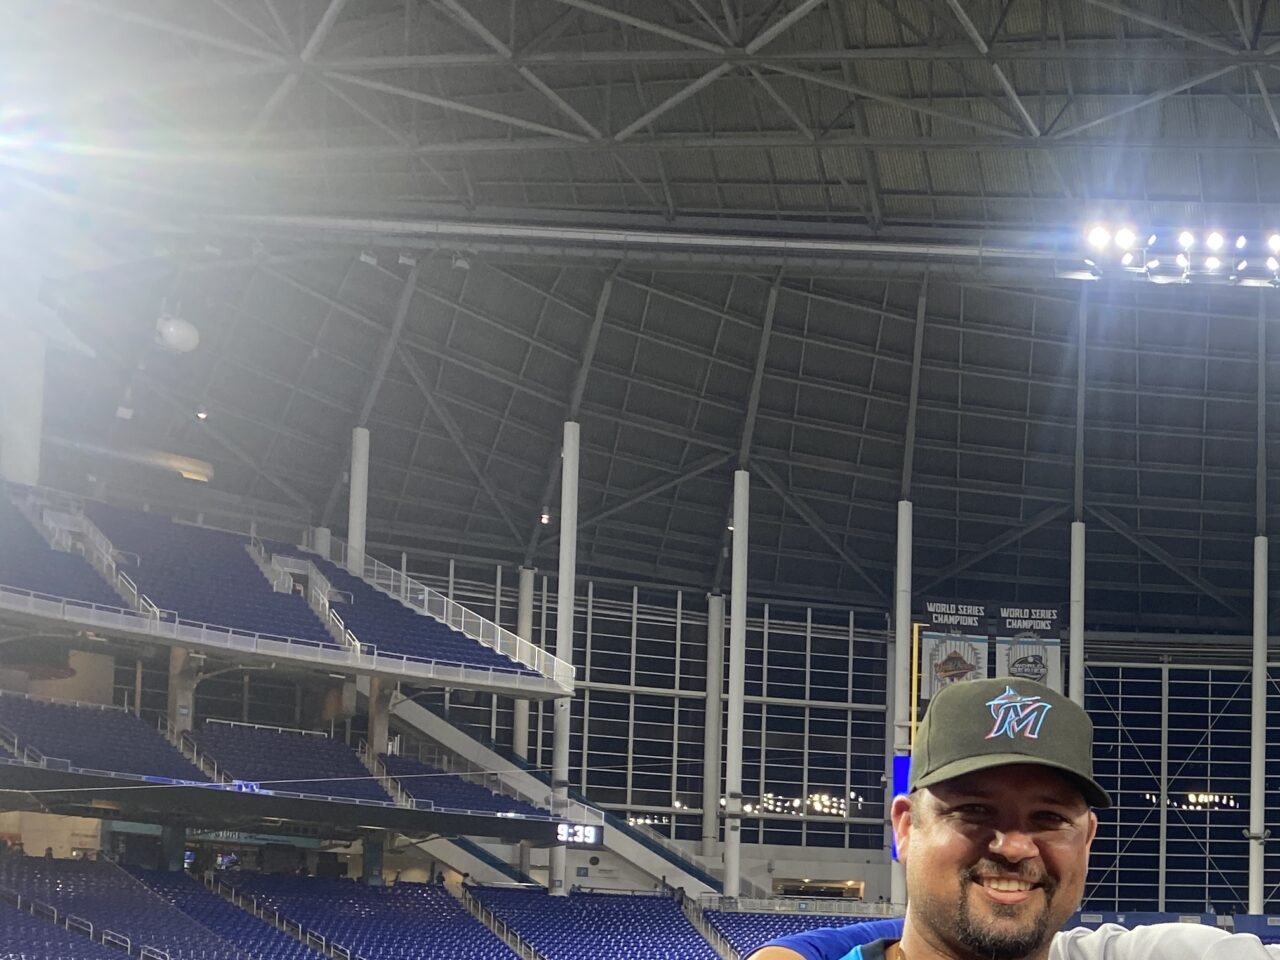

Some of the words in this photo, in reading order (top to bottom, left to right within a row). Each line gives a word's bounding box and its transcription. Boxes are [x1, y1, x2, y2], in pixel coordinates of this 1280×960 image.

[927, 602, 956, 614] WORLD
[958, 604, 985, 616] SERIES
[1000, 608, 1029, 619] WORLD
[1031, 609, 1058, 620] SERIES
[933, 613, 979, 626] CHAMPIONS
[1006, 619, 1052, 630] CHAMPIONS
